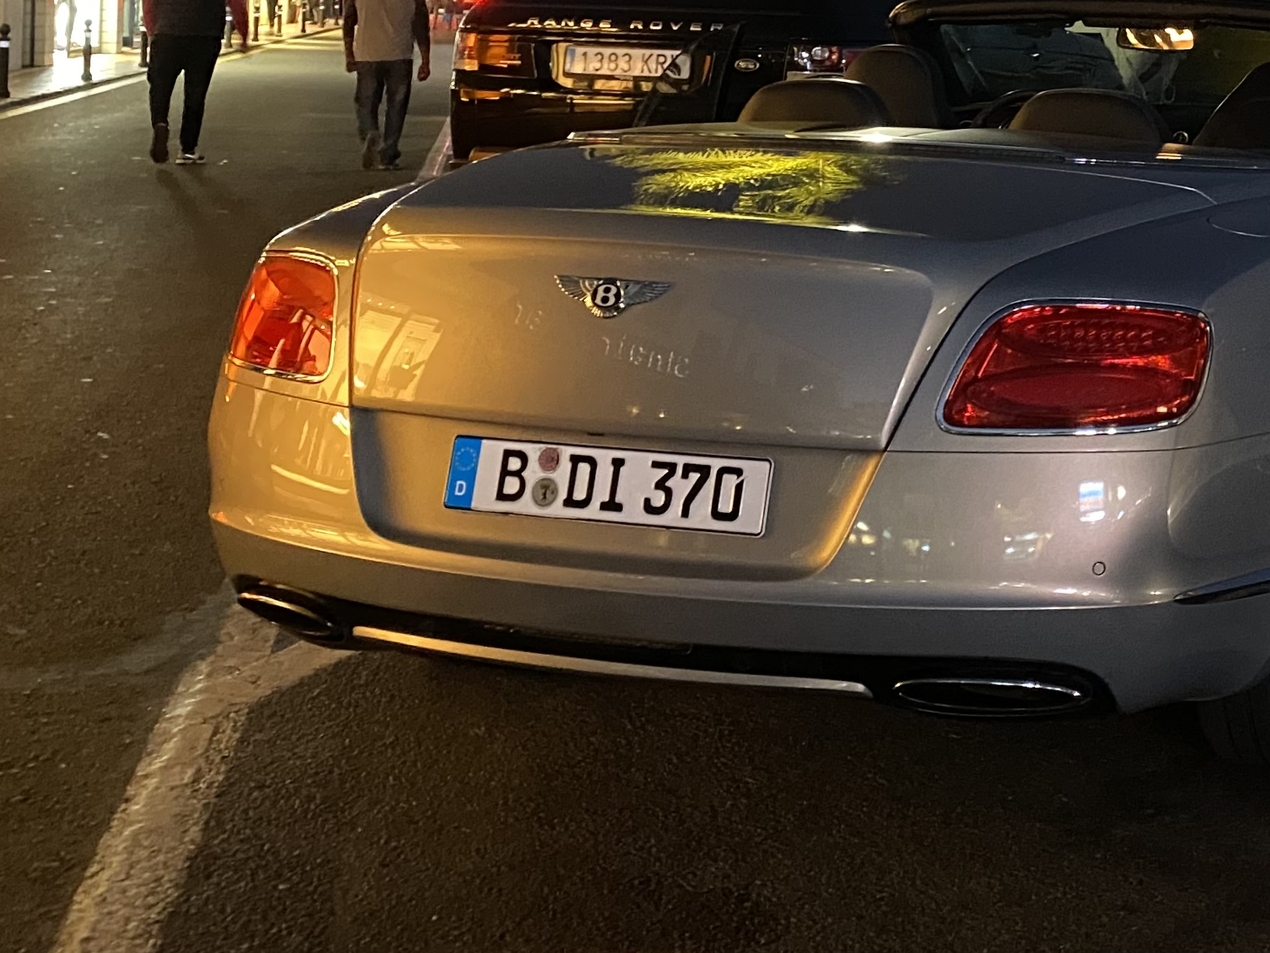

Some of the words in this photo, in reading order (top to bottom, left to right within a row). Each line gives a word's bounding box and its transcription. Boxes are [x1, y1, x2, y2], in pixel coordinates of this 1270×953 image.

[527, 17, 612, 28] RANGE
[629, 20, 724, 32] ROVER
[581, 51, 632, 73] 1383
[454, 480, 467, 496] D
[495, 449, 529, 502] B
[562, 453, 626, 513] DI
[643, 460, 744, 523] 370
